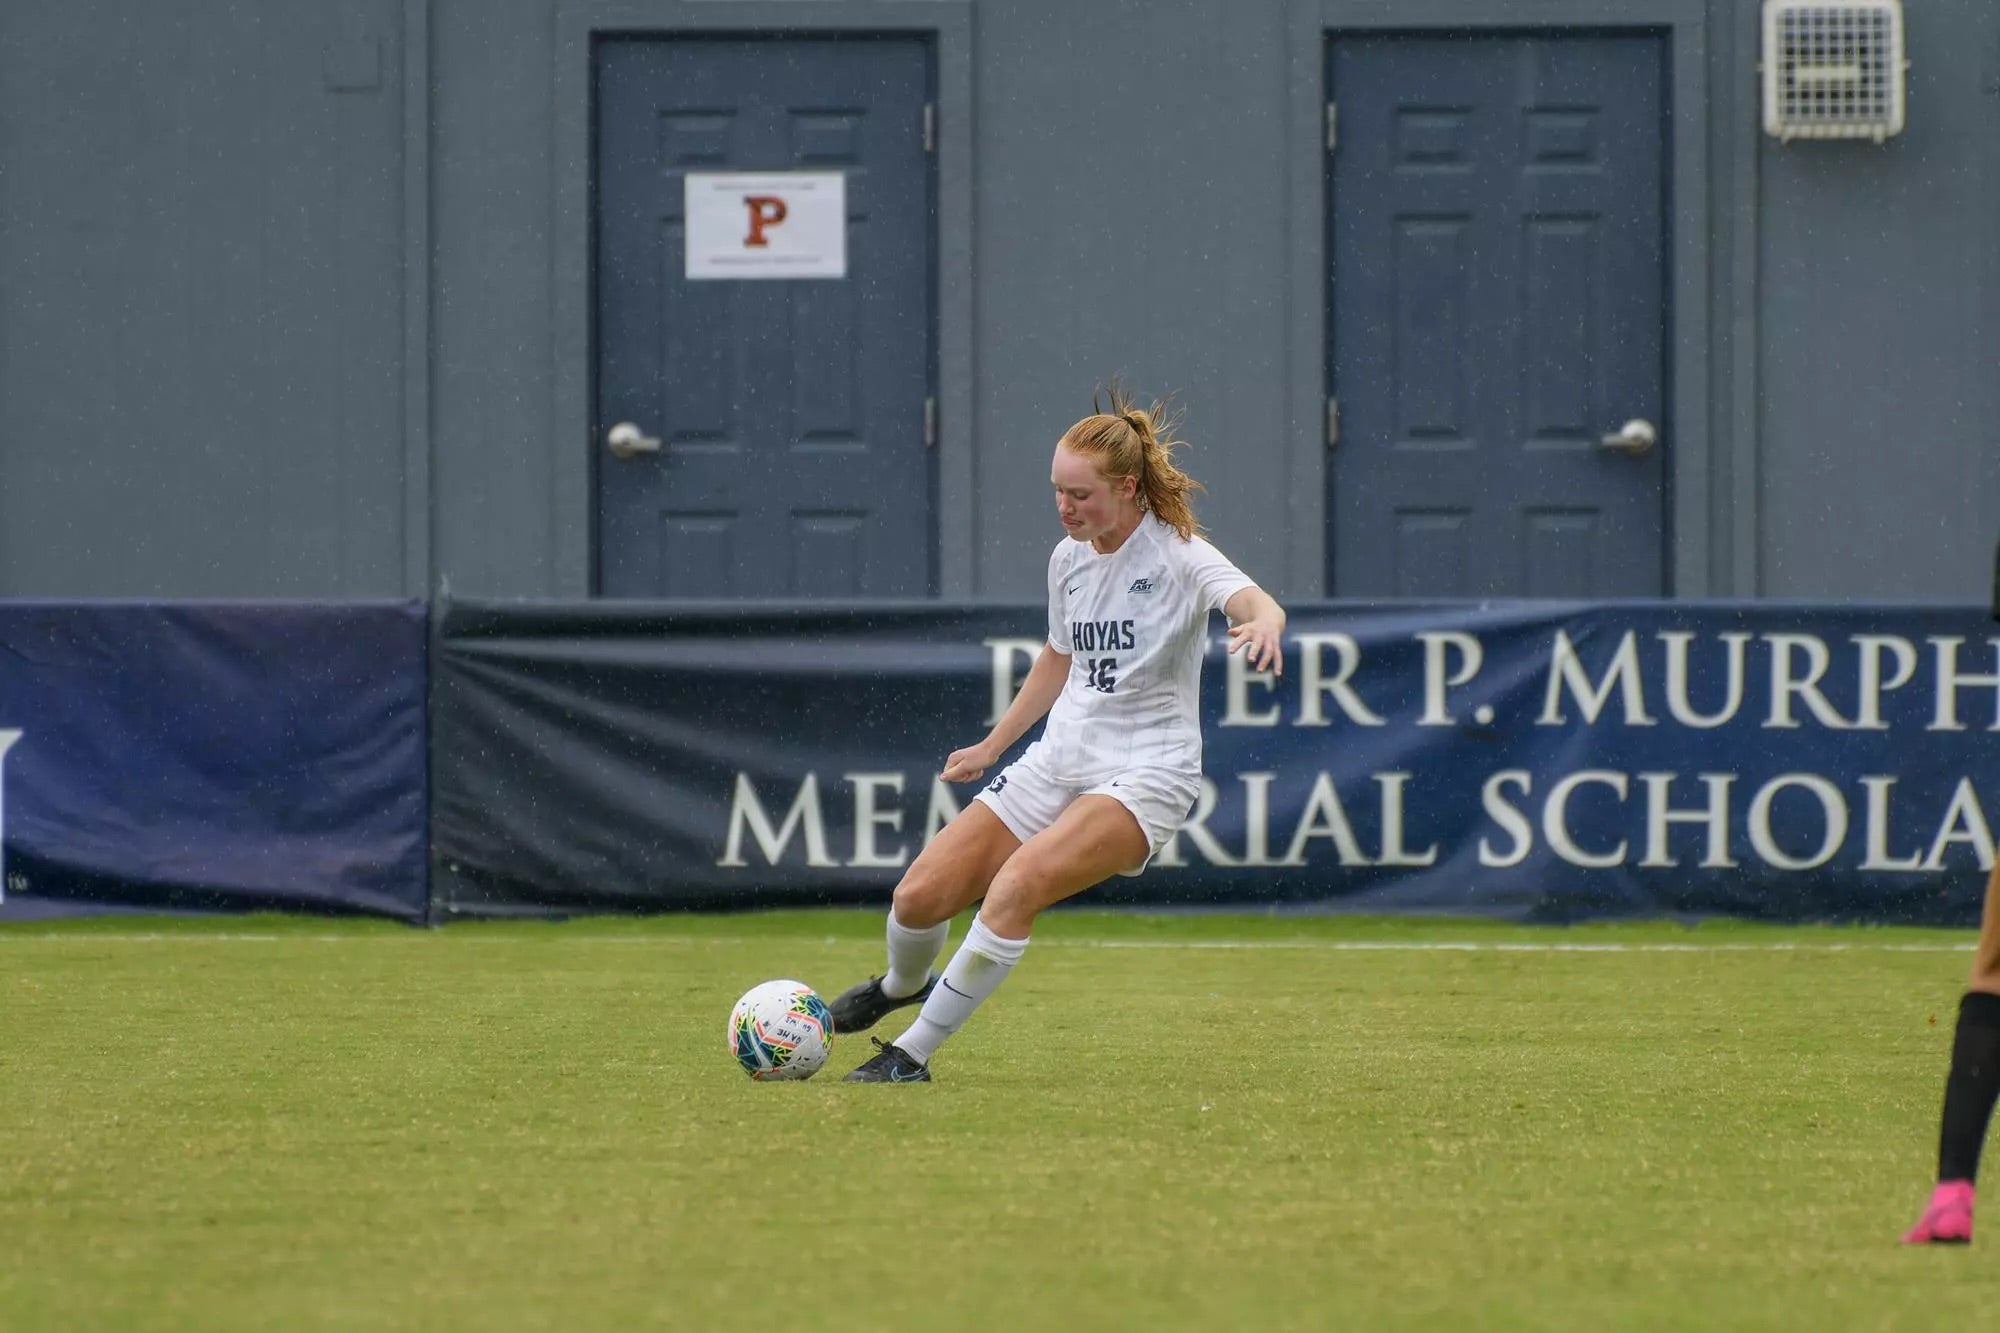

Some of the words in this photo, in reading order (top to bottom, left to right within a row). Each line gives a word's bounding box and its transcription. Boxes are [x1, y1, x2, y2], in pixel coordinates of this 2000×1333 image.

[743, 195, 788, 248] P
[1072, 620, 1135, 651] HOYAS
[982, 635, 1387, 728] PER
[1415, 631, 1493, 727] P.
[1085, 658, 1117, 693] 16
[716, 770, 1437, 868] MERIAL
[1478, 768, 1997, 872] SCHOLA
